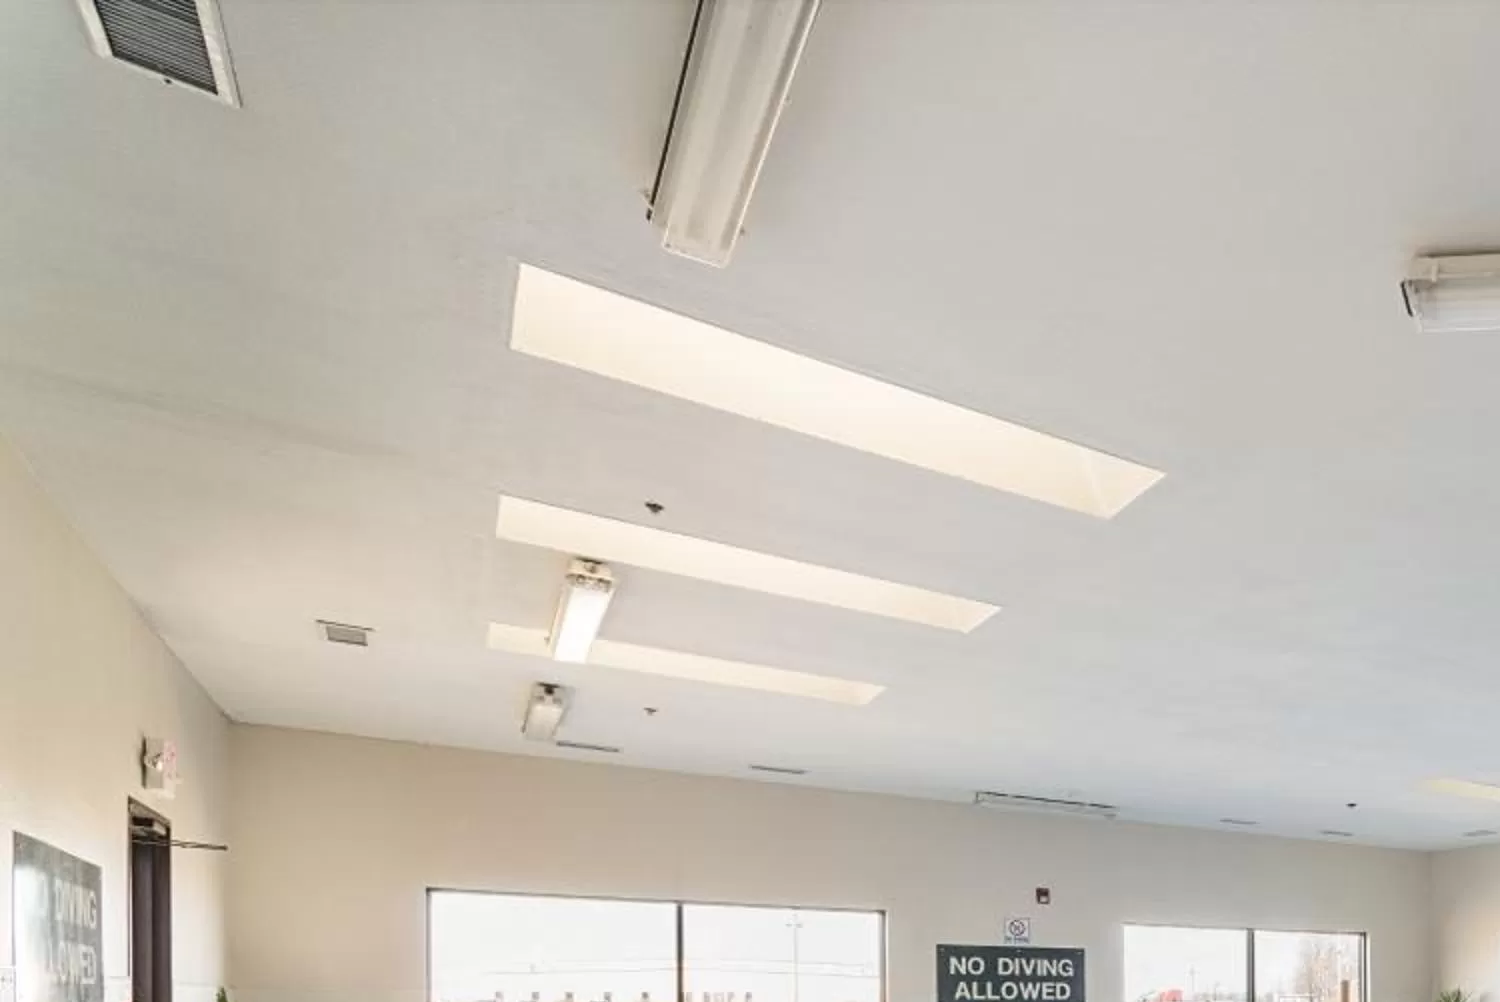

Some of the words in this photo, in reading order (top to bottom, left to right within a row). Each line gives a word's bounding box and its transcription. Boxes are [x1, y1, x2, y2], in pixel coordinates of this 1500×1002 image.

[949, 956, 985, 976] NO
[997, 957, 1075, 977] DIVING
[955, 981, 1071, 1000] ALLOWED
